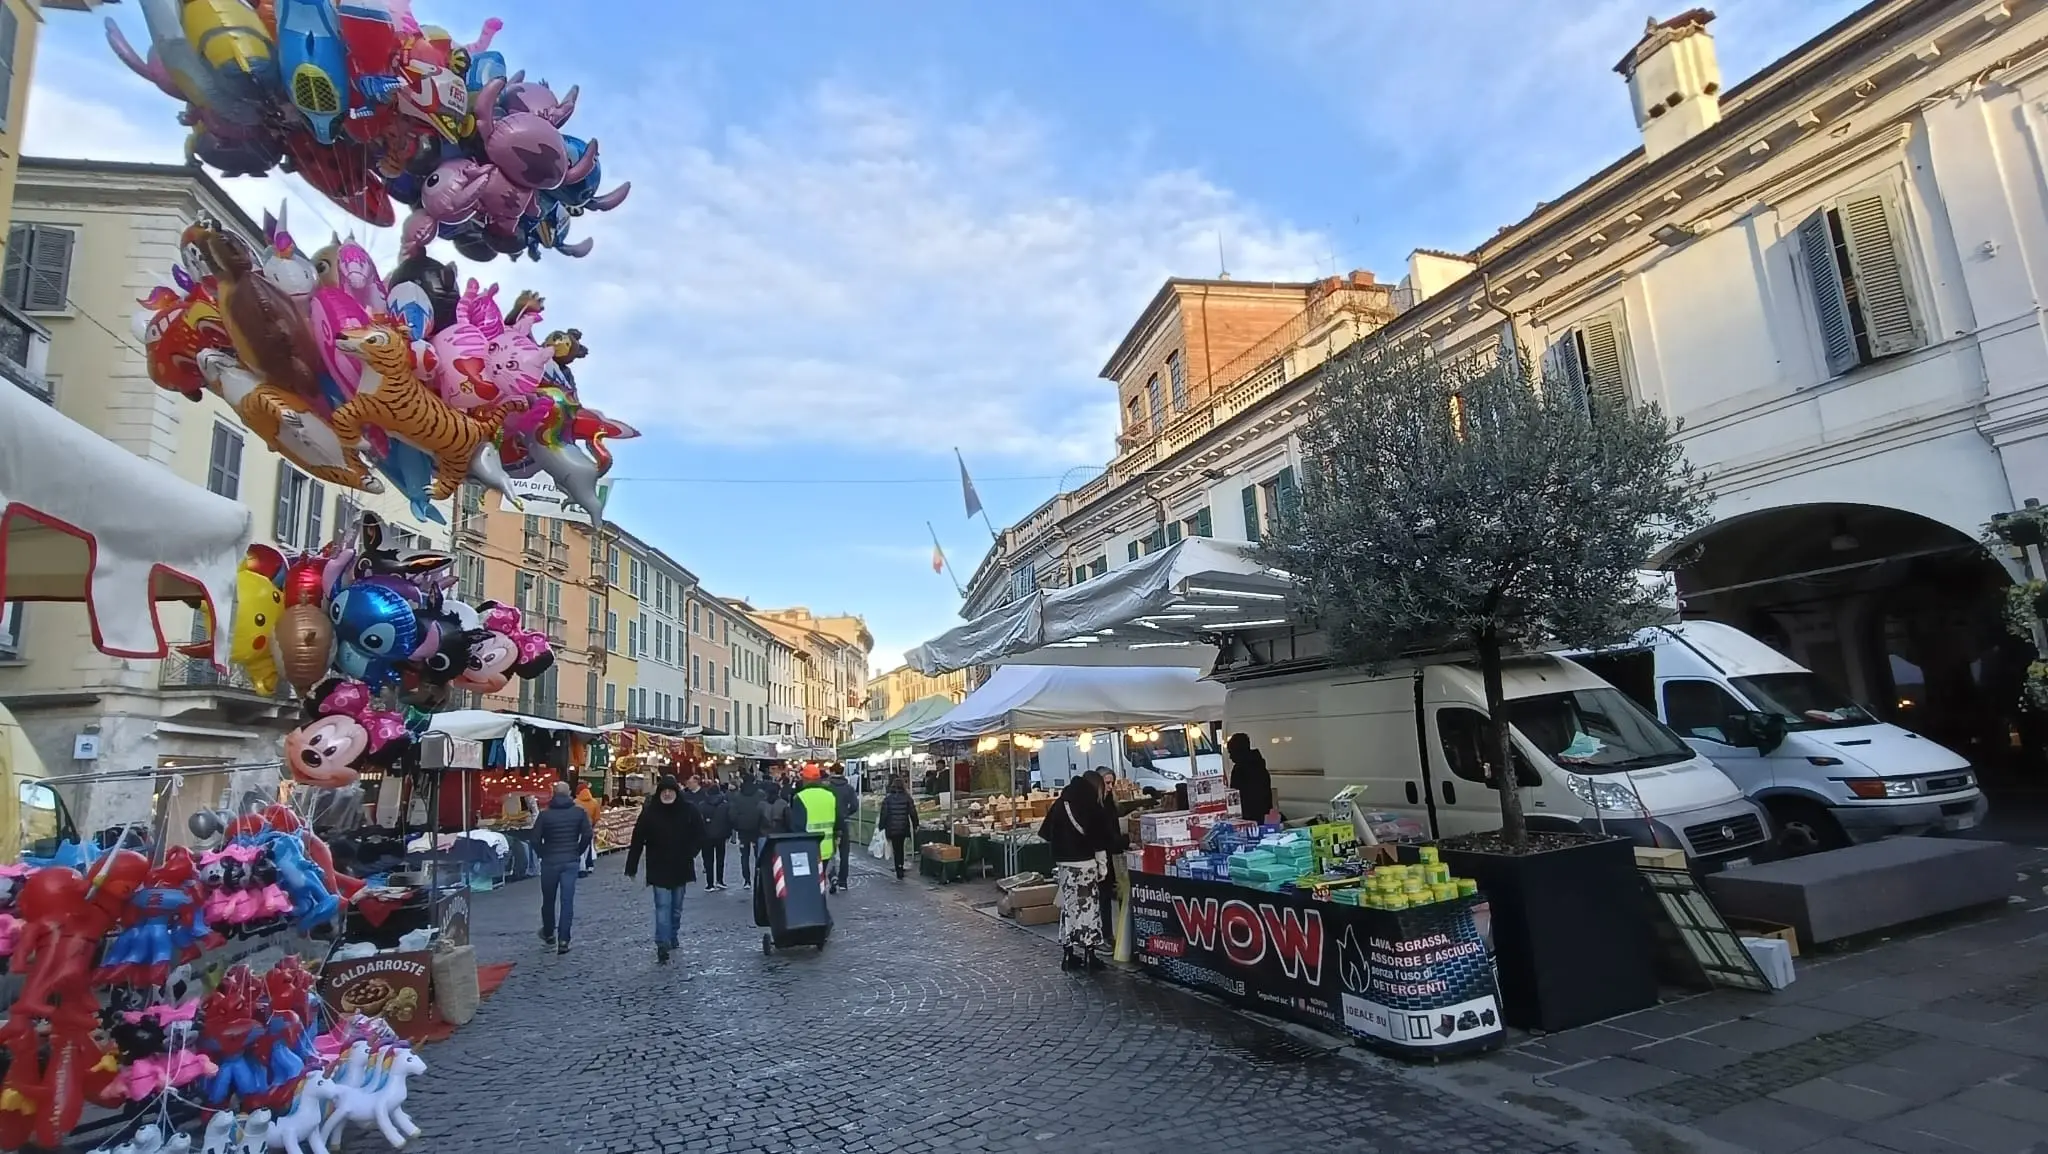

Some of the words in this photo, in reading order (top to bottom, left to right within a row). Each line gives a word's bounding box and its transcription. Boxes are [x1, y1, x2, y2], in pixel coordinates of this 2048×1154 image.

[513, 480, 528, 488] VIA
[530, 482, 541, 492] DI
[1171, 895, 1324, 986] WOW
[1369, 936, 1394, 953] LAVA,
[1395, 933, 1451, 952] SGRASSA,
[1371, 951, 1422, 967] ASSORBE
[1425, 953, 1433, 964] E
[1435, 942, 1480, 962] ASCIUGA
[331, 959, 426, 988] CALDARROSTE
[1423, 966, 1433, 978] di
[1373, 979, 1447, 995] DETERGENTI
[1345, 1005, 1374, 1023] IDEALE
